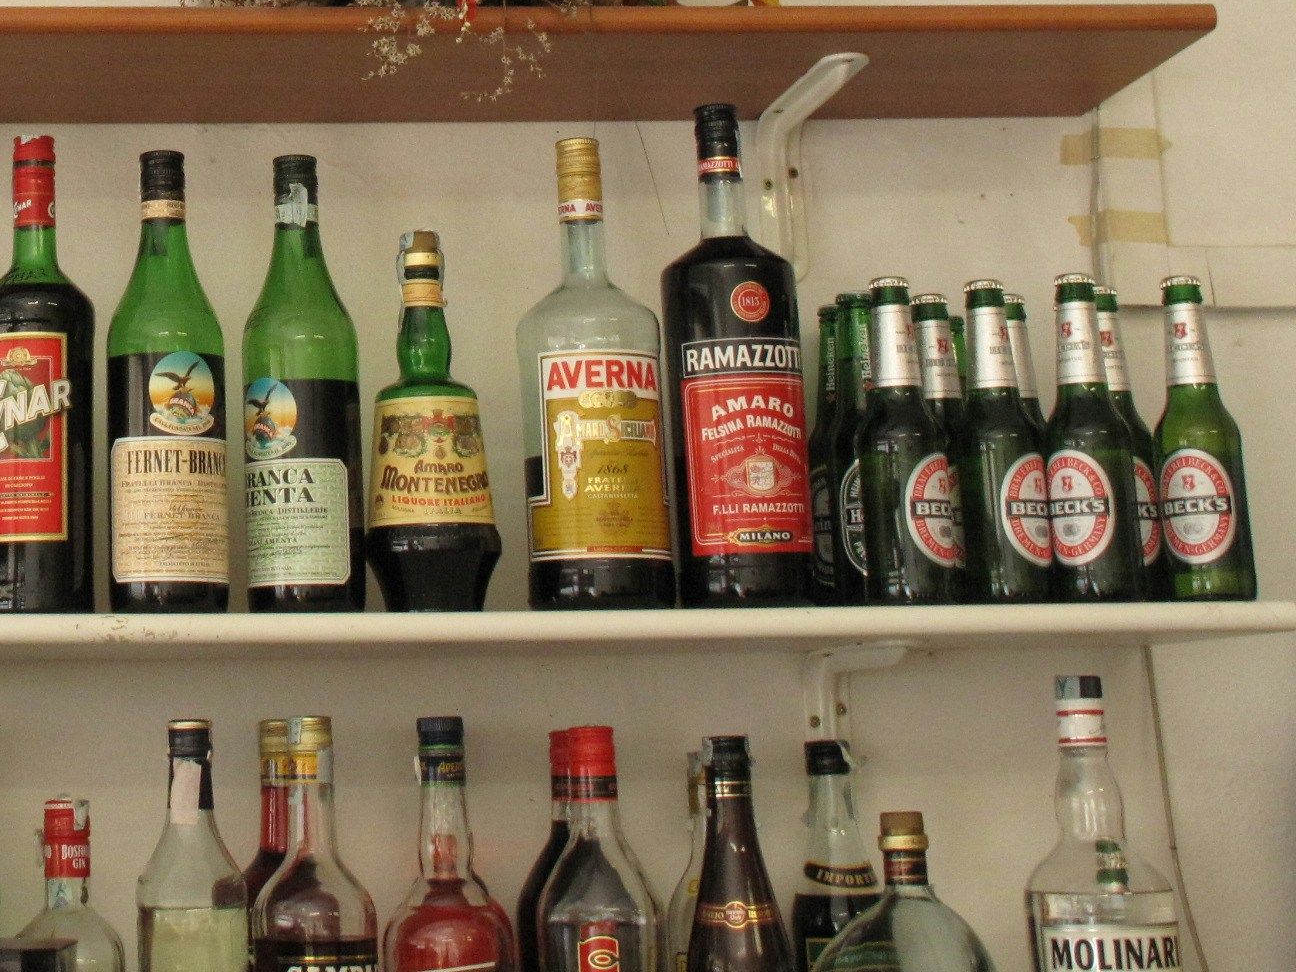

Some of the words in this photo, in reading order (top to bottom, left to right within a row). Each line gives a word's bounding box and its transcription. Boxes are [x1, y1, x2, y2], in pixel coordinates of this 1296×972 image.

[686, 344, 802, 372] RAMAZZOTTI
[547, 359, 657, 391] AVERNA
[711, 394, 794, 421] AMARO
[702, 418, 744, 441] FELSINA
[746, 414, 802, 439] RAMAZZOTTI
[127, 450, 225, 474] FERNET-BRANC
[247, 469, 314, 488] RANCA
[380, 465, 489, 495] MONTENEGRO
[392, 495, 440, 507] LIQUORE
[444, 493, 486, 507] ITALIANO
[713, 504, 739, 515] F.LLI
[742, 502, 804, 513] RAMAZZOTTI
[916, 502, 951, 516] BEC
[1011, 501, 1048, 515] BEC
[1164, 497, 1228, 516] BECK'S
[739, 531, 791, 541] MILANO
[1051, 936, 1180, 971] MOLINARI
